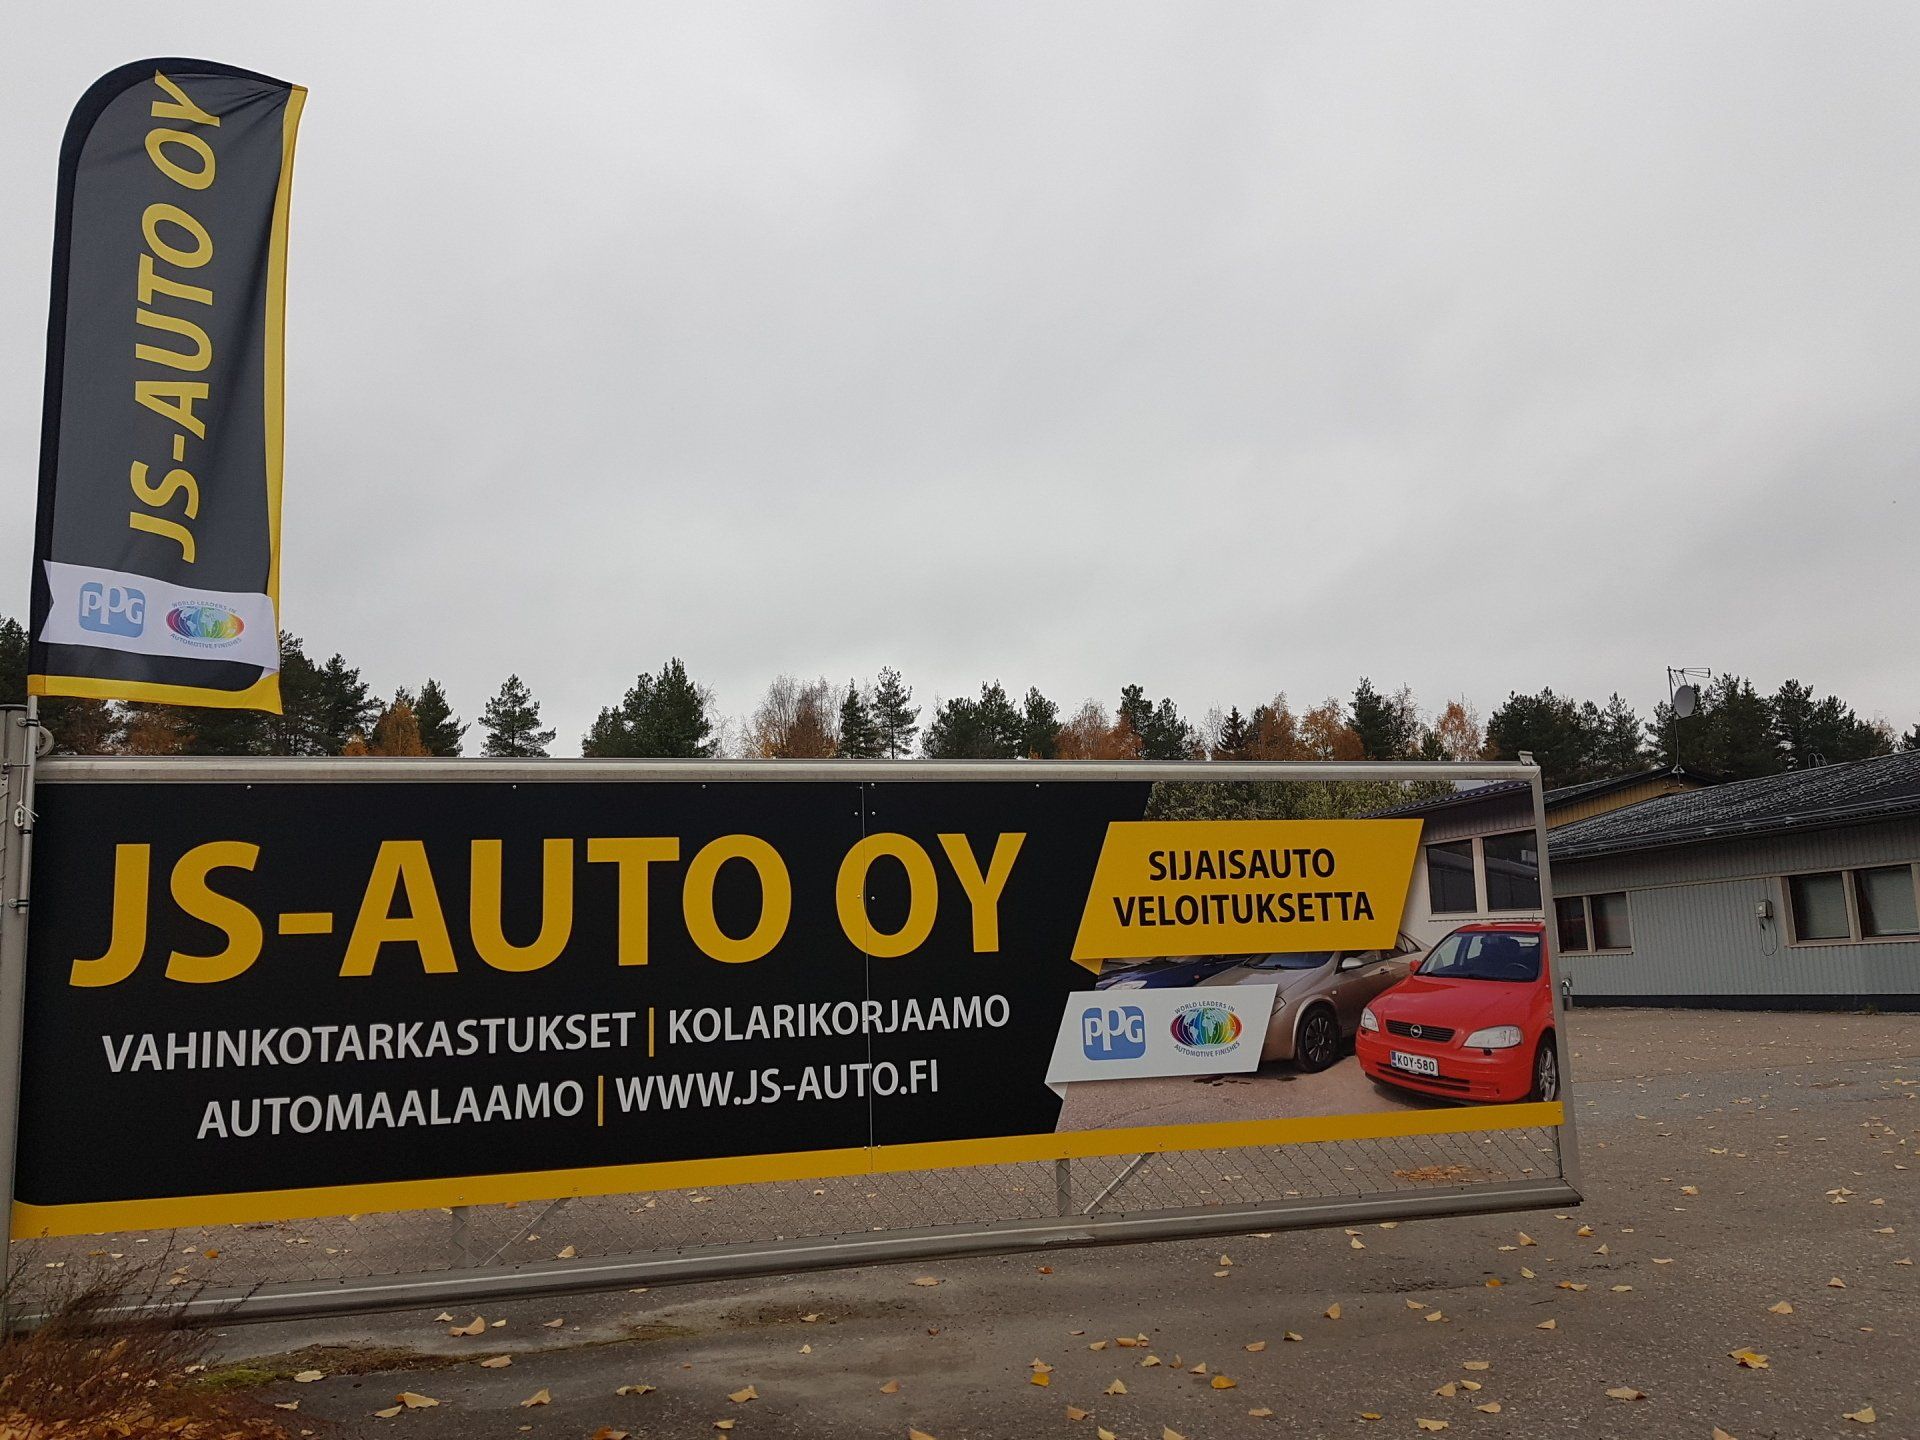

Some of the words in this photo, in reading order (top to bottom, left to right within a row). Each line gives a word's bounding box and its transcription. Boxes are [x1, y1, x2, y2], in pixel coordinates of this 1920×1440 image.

[144, 69, 221, 191] OY
[129, 203, 214, 564] JS-AUTO
[81, 585, 145, 625] PPG
[1147, 848, 1336, 881] SIJAISAUTO
[69, 833, 792, 988] JS-AUTO
[835, 832, 1027, 958] OY
[1113, 891, 1375, 927] VELOITUKSETTA
[1175, 1001, 1197, 1014] WORLD
[1198, 1000, 1227, 1009] LEADERS
[1227, 1004, 1235, 1012] IN
[102, 1011, 636, 1073] VAHINKOTARKASTUKSET
[669, 995, 1010, 1044] KOLARIKORJAAMO
[1084, 1007, 1143, 1051] PPG
[1174, 1044, 1214, 1057] AUTOMOTIVE
[1215, 1041, 1240, 1056] FINISHES
[1397, 1054, 1435, 1072] KOY-580
[197, 1080, 584, 1140] AUTOMAALAAMO
[615, 1059, 939, 1113] WWW.JS-AUTO.FI
